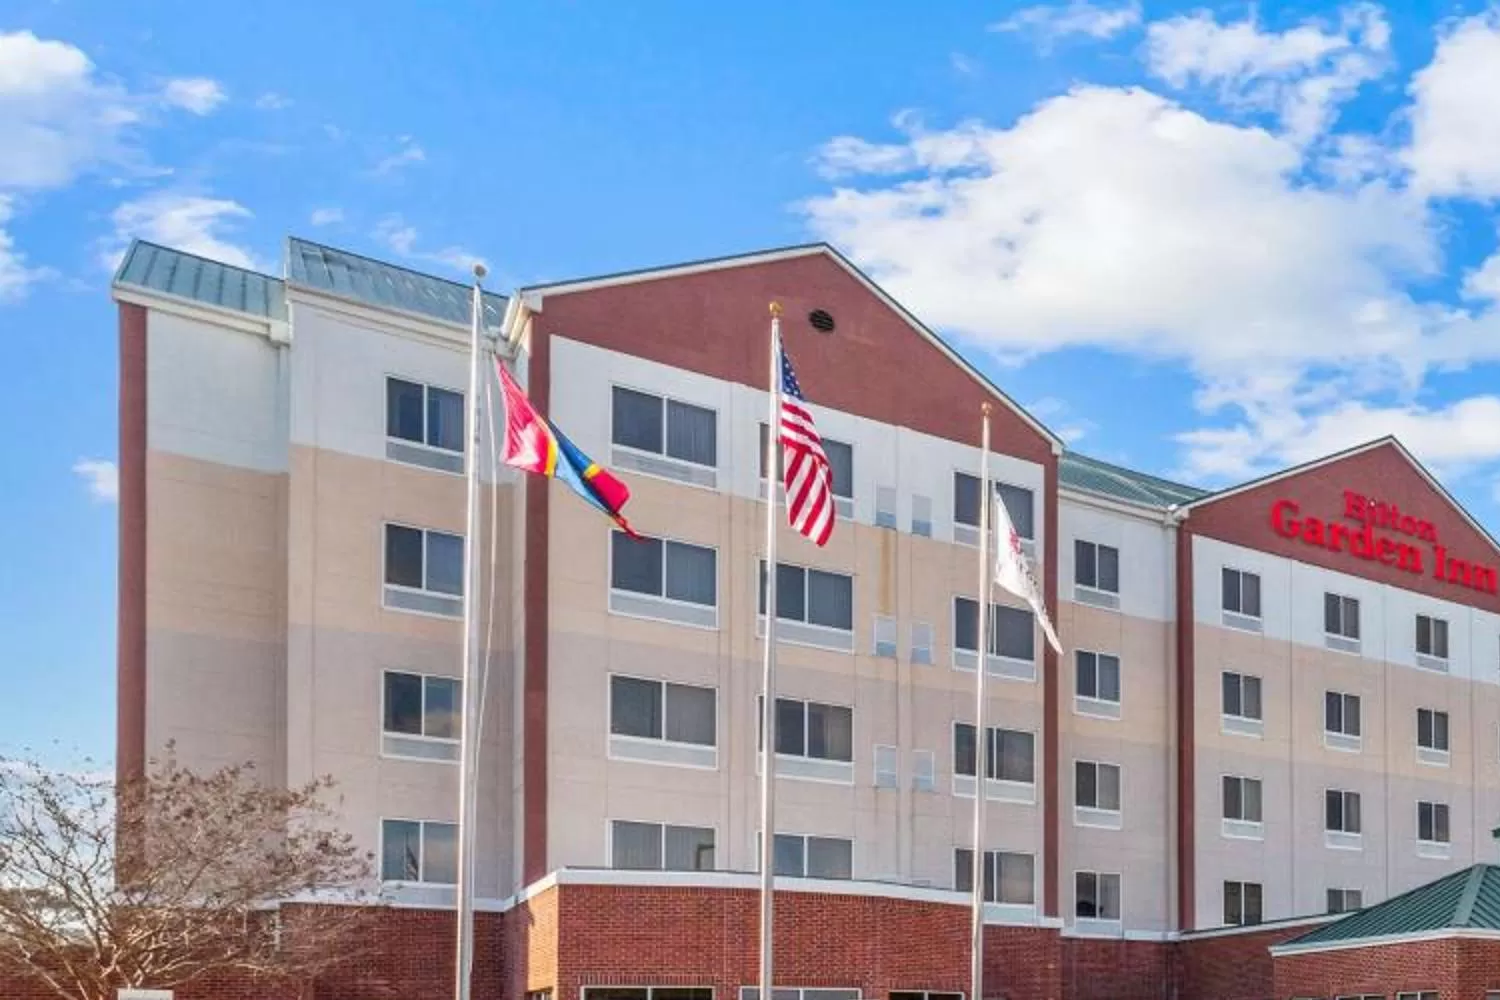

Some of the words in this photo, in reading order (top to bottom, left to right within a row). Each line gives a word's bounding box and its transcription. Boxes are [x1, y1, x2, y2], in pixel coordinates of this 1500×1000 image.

[1269, 498, 1424, 575] Garden
[1433, 544, 1498, 595] Inn
[1343, 490, 1439, 543] Hilton
